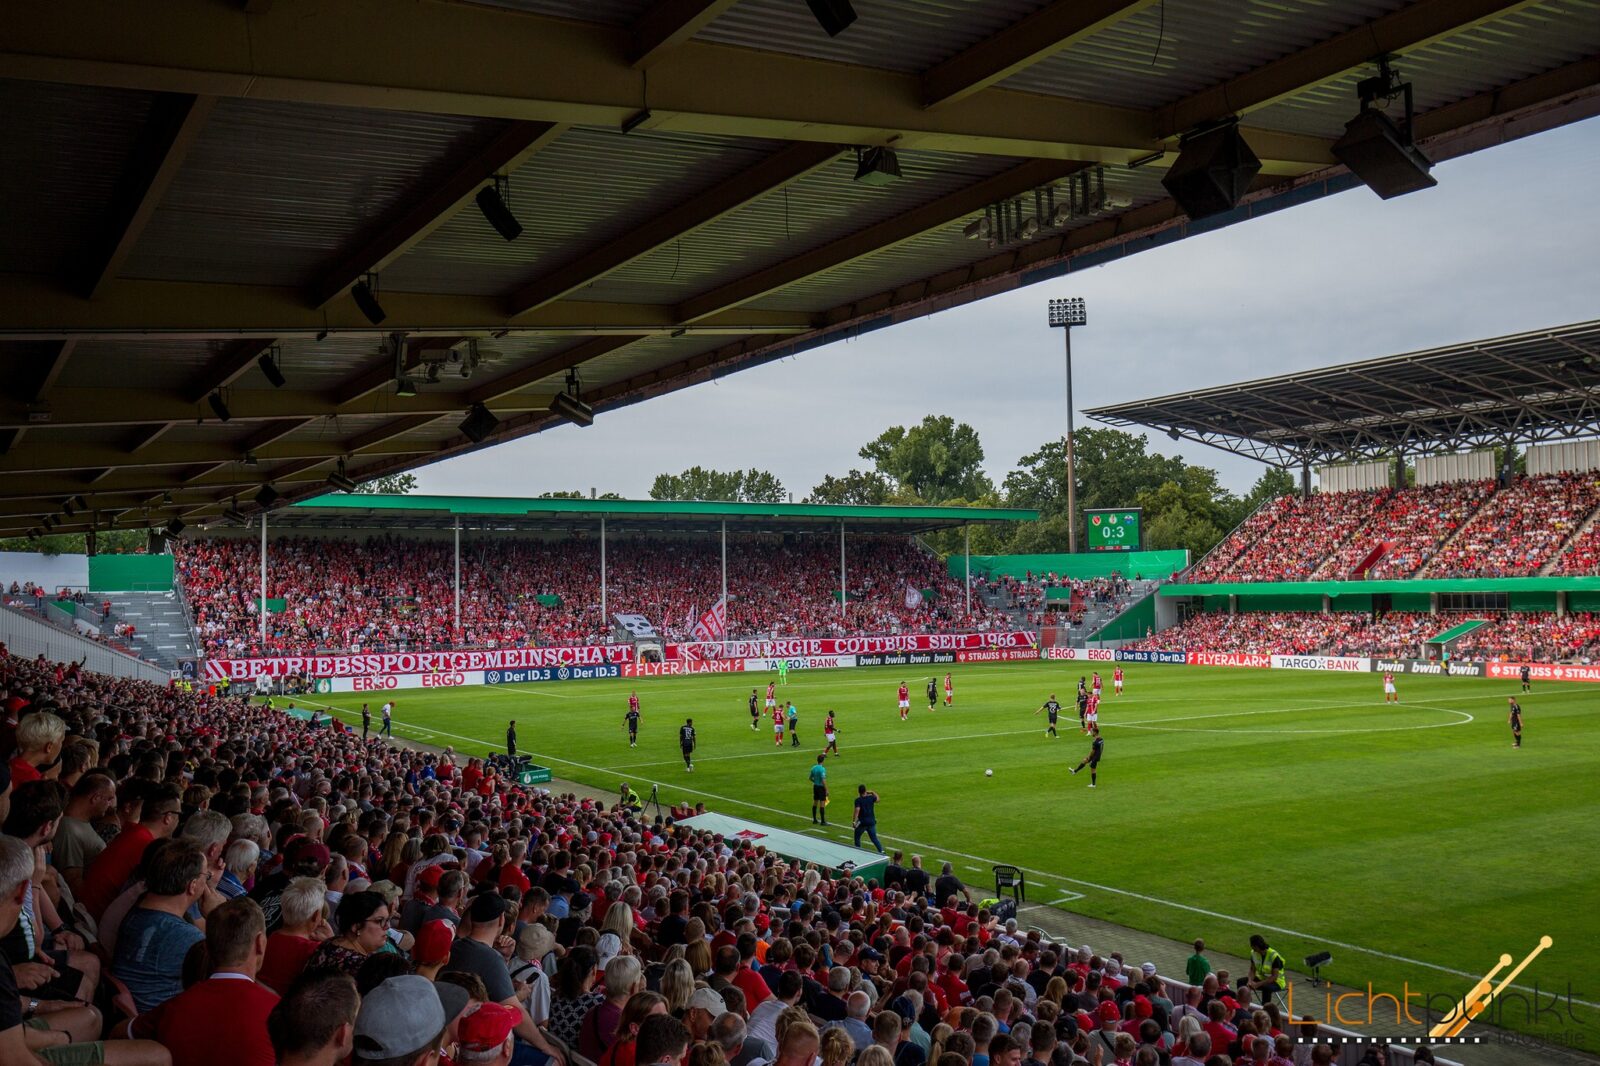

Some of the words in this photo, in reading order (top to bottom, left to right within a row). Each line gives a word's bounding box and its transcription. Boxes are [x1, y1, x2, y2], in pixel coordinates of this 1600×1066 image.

[1102, 526, 1125, 538] 0:3
[735, 639, 823, 659] ENERGIE
[834, 635, 918, 654] COTTBUS
[929, 634, 968, 649] SEIT
[979, 633, 1016, 649] 1966
[884, 654, 906, 665] bwin
[909, 653, 931, 664] bwin
[933, 652, 954, 663] bwin
[968, 651, 1000, 661] STRAUSS
[1009, 650, 1038, 660] STRAUSS
[1048, 648, 1076, 659] ERGO
[1088, 649, 1112, 660] ERGO
[1123, 652, 1135, 660] Der
[1135, 652, 1148, 661] ID.3
[1160, 653, 1172, 662] Der
[1172, 653, 1186, 663] ID.3
[229, 644, 633, 680] BETRIEBSSPORTGEMEINSCHAFT
[859, 655, 881, 666] bwin
[1198, 653, 1269, 667] FLYERALARM
[1376, 659, 1405, 672] bwin
[573, 668, 594, 679] Der
[596, 666, 618, 678] ID.3
[636, 660, 731, 676] FLYERALARM
[1411, 661, 1441, 674] bwin
[1448, 662, 1480, 675] bwin
[421, 672, 465, 687] ERGO
[505, 671, 526, 682] Der
[528, 669, 551, 681] ID.3
[353, 676, 398, 691] ERGO
